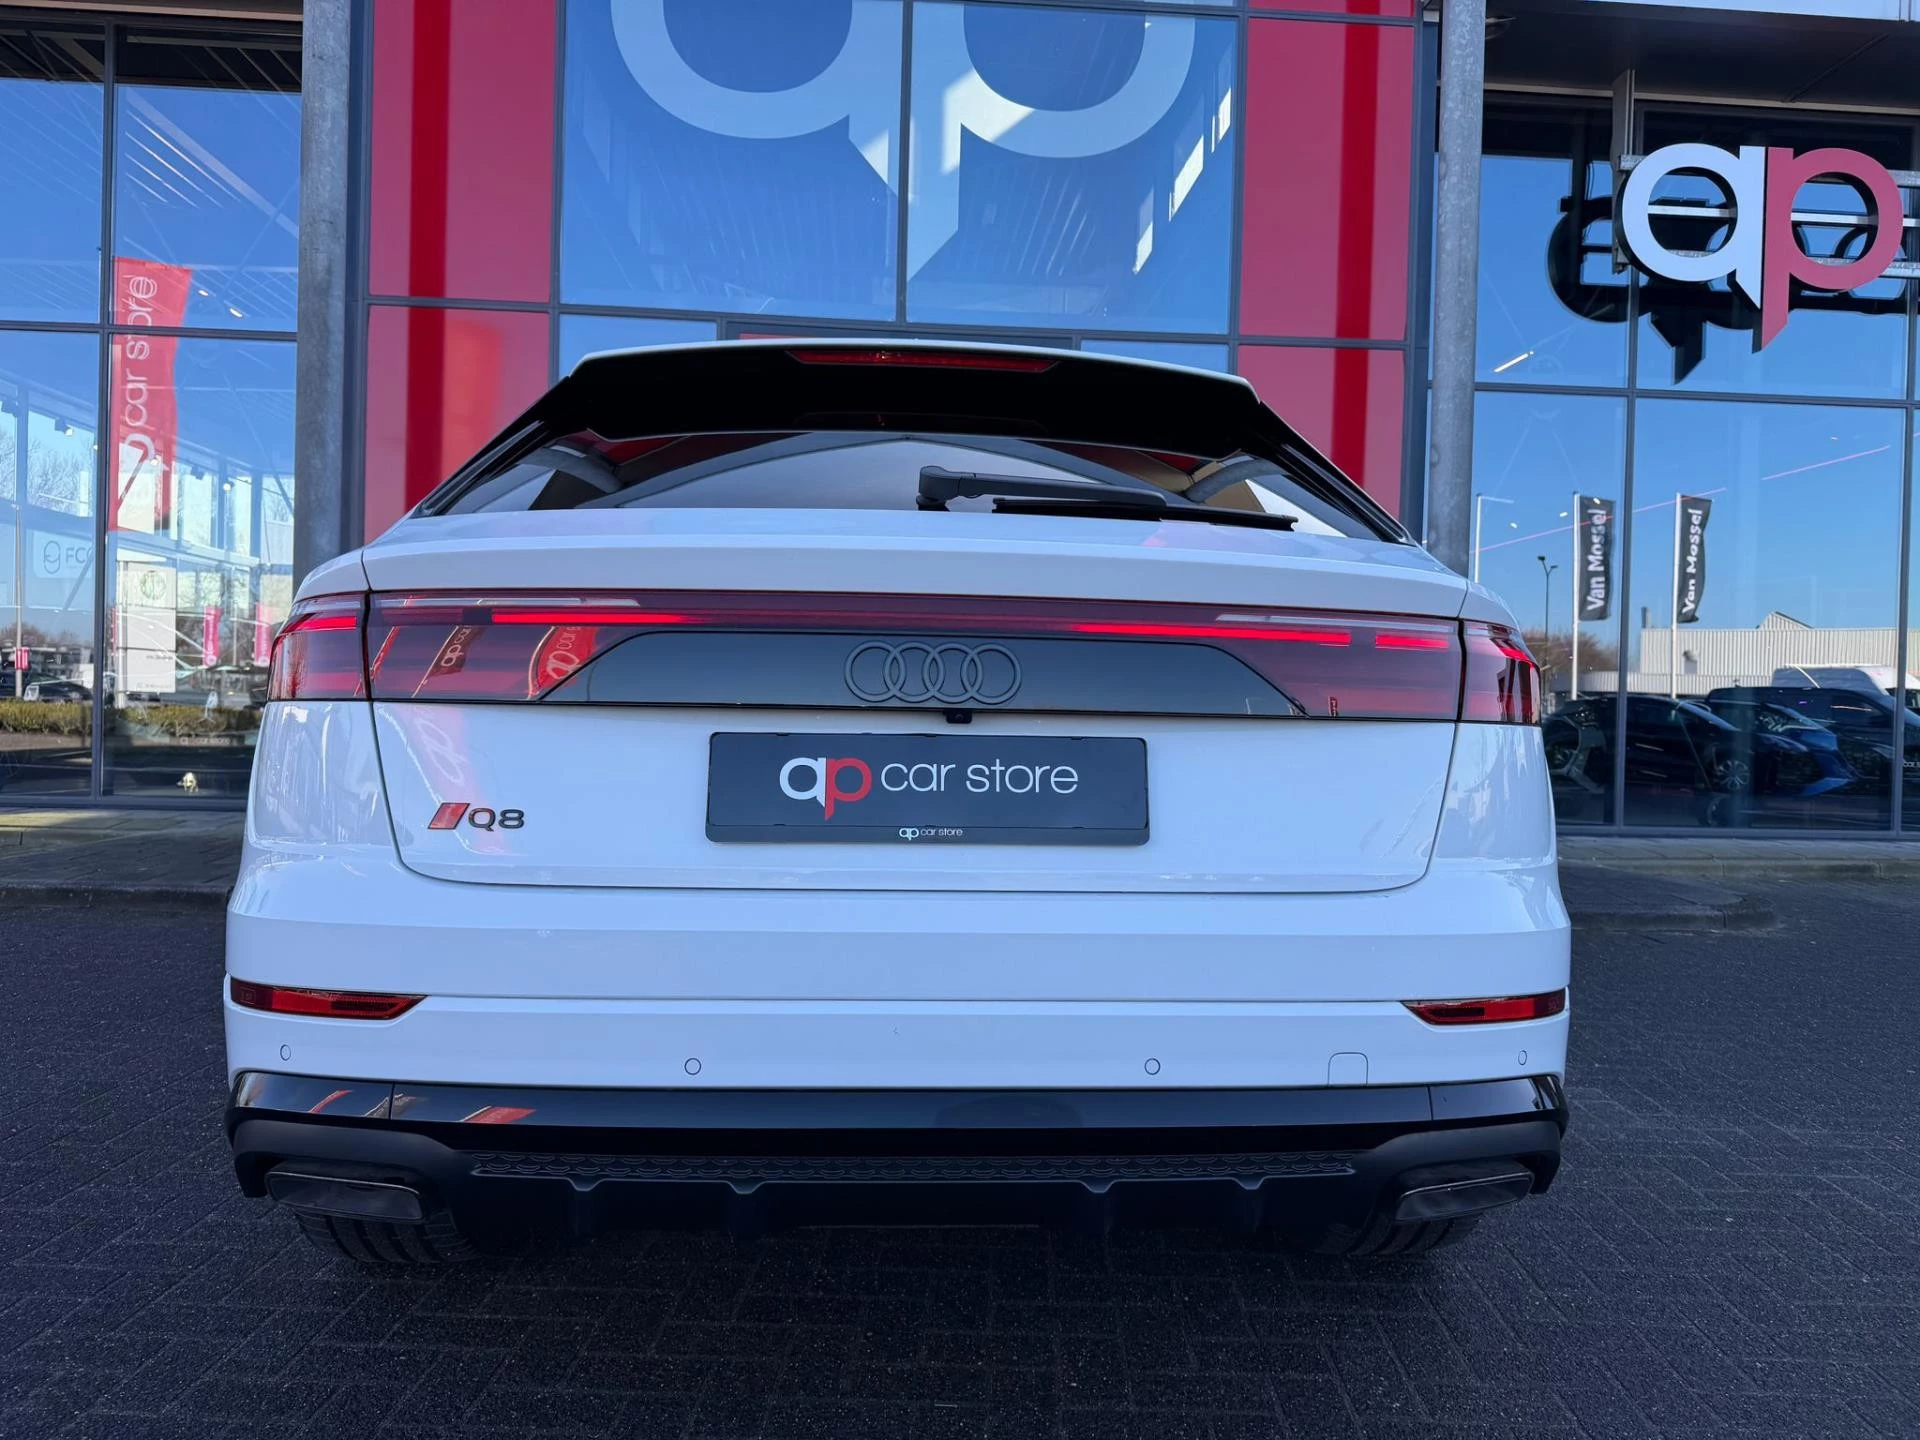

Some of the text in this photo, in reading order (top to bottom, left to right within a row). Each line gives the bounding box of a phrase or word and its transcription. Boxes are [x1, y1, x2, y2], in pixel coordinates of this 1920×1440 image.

[1622, 143, 1904, 350] ap
[126, 275, 158, 360] sore
[125, 368, 149, 427] car
[1586, 508, 1607, 611] Van Mossel
[1682, 508, 1703, 614] Van Mossel
[468, 807, 525, 832] Q8
[779, 757, 1079, 821] ap car store
[899, 827, 920, 841] ap
[938, 827, 963, 836] store
